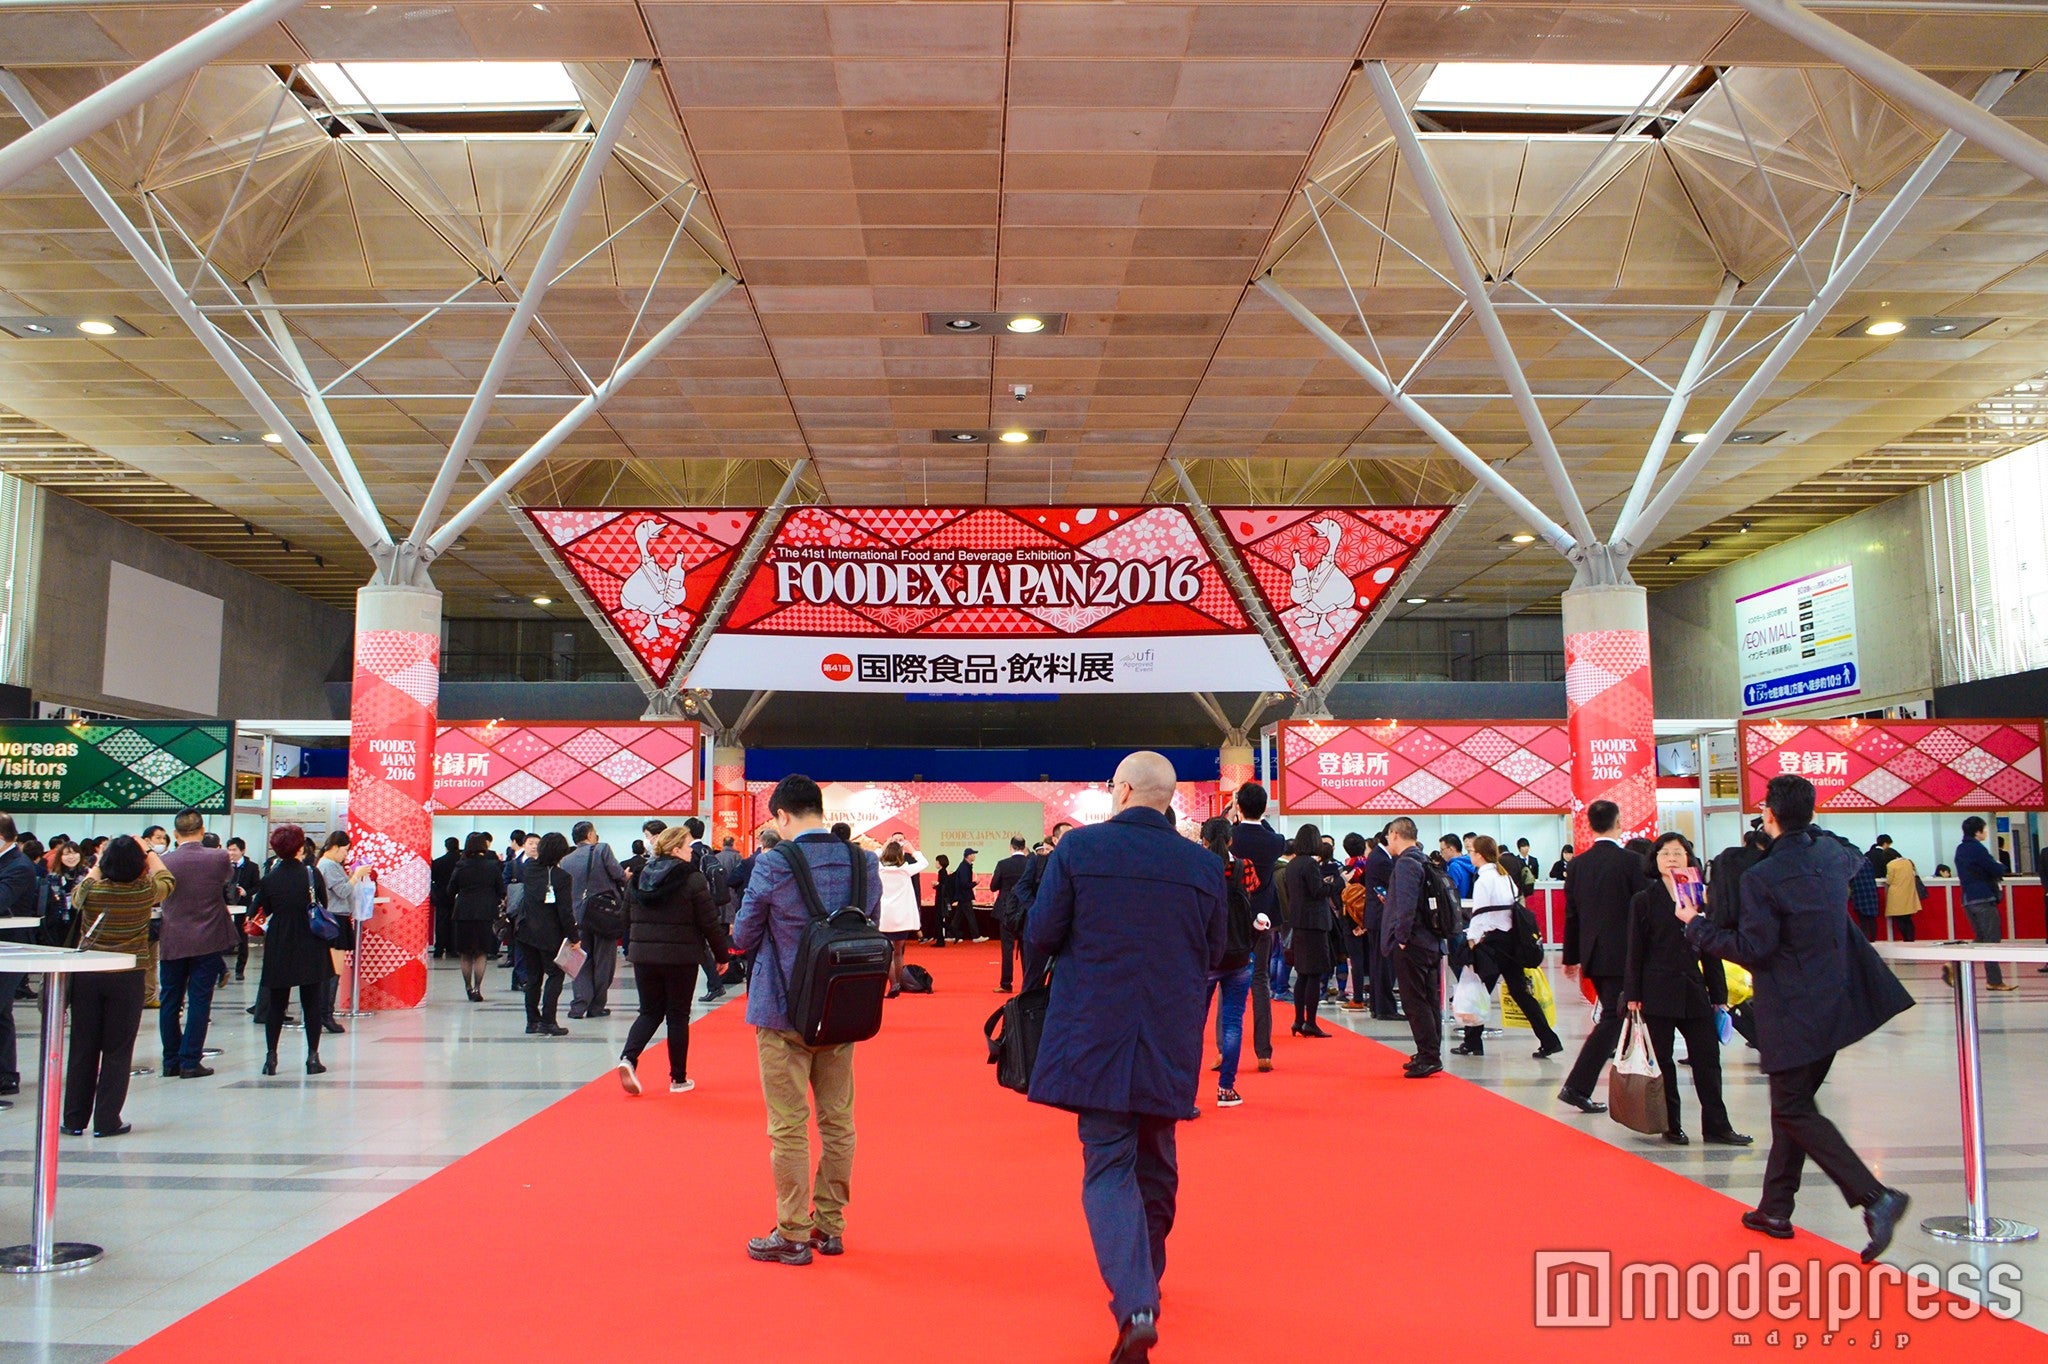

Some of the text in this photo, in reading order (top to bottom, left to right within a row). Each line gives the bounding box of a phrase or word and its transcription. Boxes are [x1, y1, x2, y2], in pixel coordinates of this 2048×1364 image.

[777, 547, 1071, 563] The 41st International Food and Beverage Exhibition
[775, 559, 1200, 606] FOODEX JAPAN 2016
[369, 739, 416, 754] FOODEX
[1590, 739, 1637, 753] FOODEX
[380, 753, 416, 767] JAPAN
[1317, 751, 1389, 777] 登録所
[1591, 752, 1627, 766] JAPAN
[1778, 751, 1848, 776] 登録所
[385, 767, 416, 780] 2016
[1592, 766, 1623, 780] 2016
[1320, 777, 1385, 789] Registration
